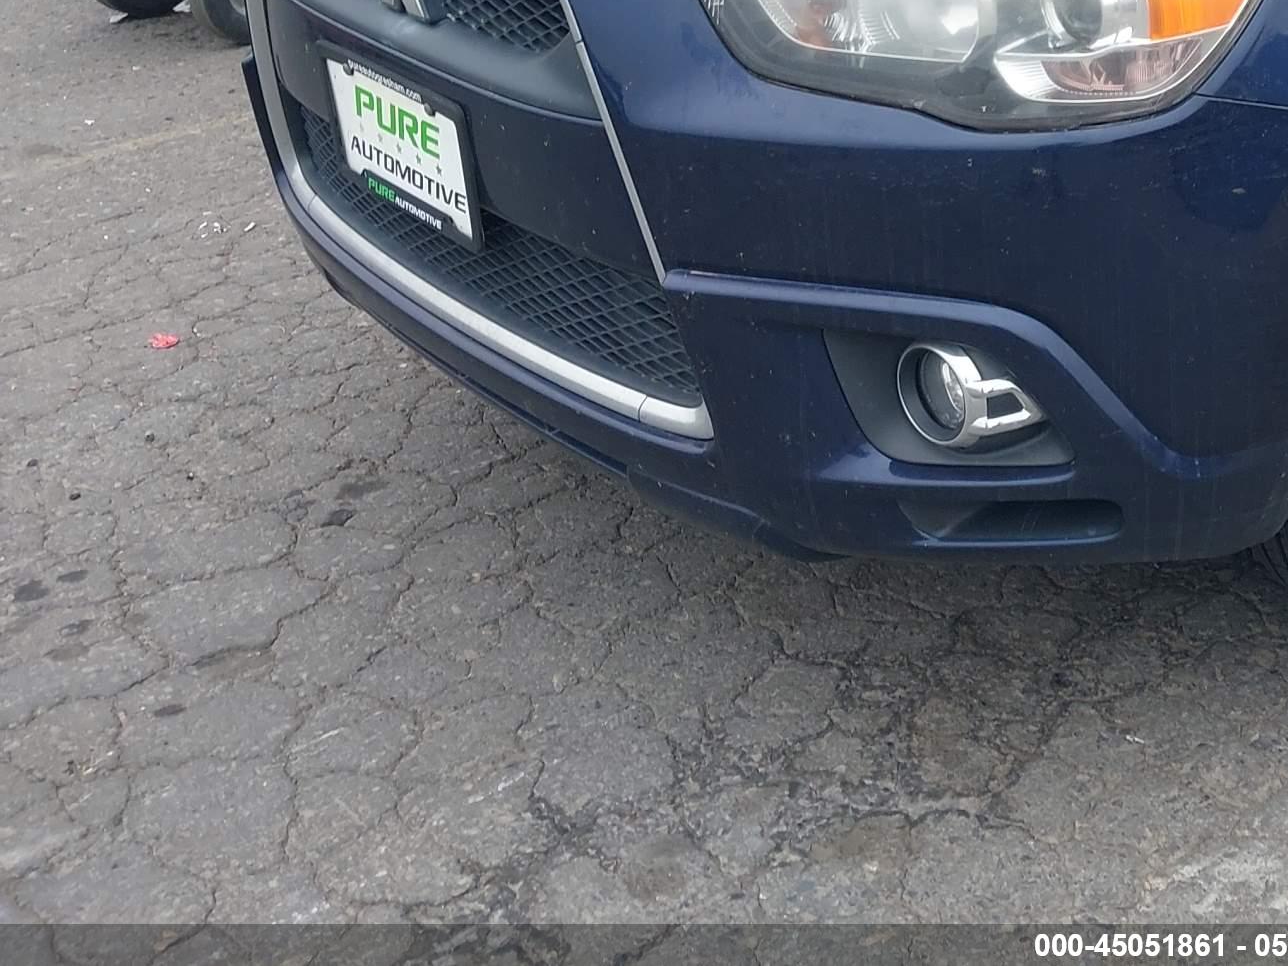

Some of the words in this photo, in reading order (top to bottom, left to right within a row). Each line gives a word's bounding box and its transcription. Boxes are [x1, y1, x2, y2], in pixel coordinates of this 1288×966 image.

[354, 83, 441, 160] PURE
[350, 135, 467, 215] AUTOMOTIVE
[368, 177, 395, 202] PURE
[395, 195, 442, 230] AUTOMOTIVE
